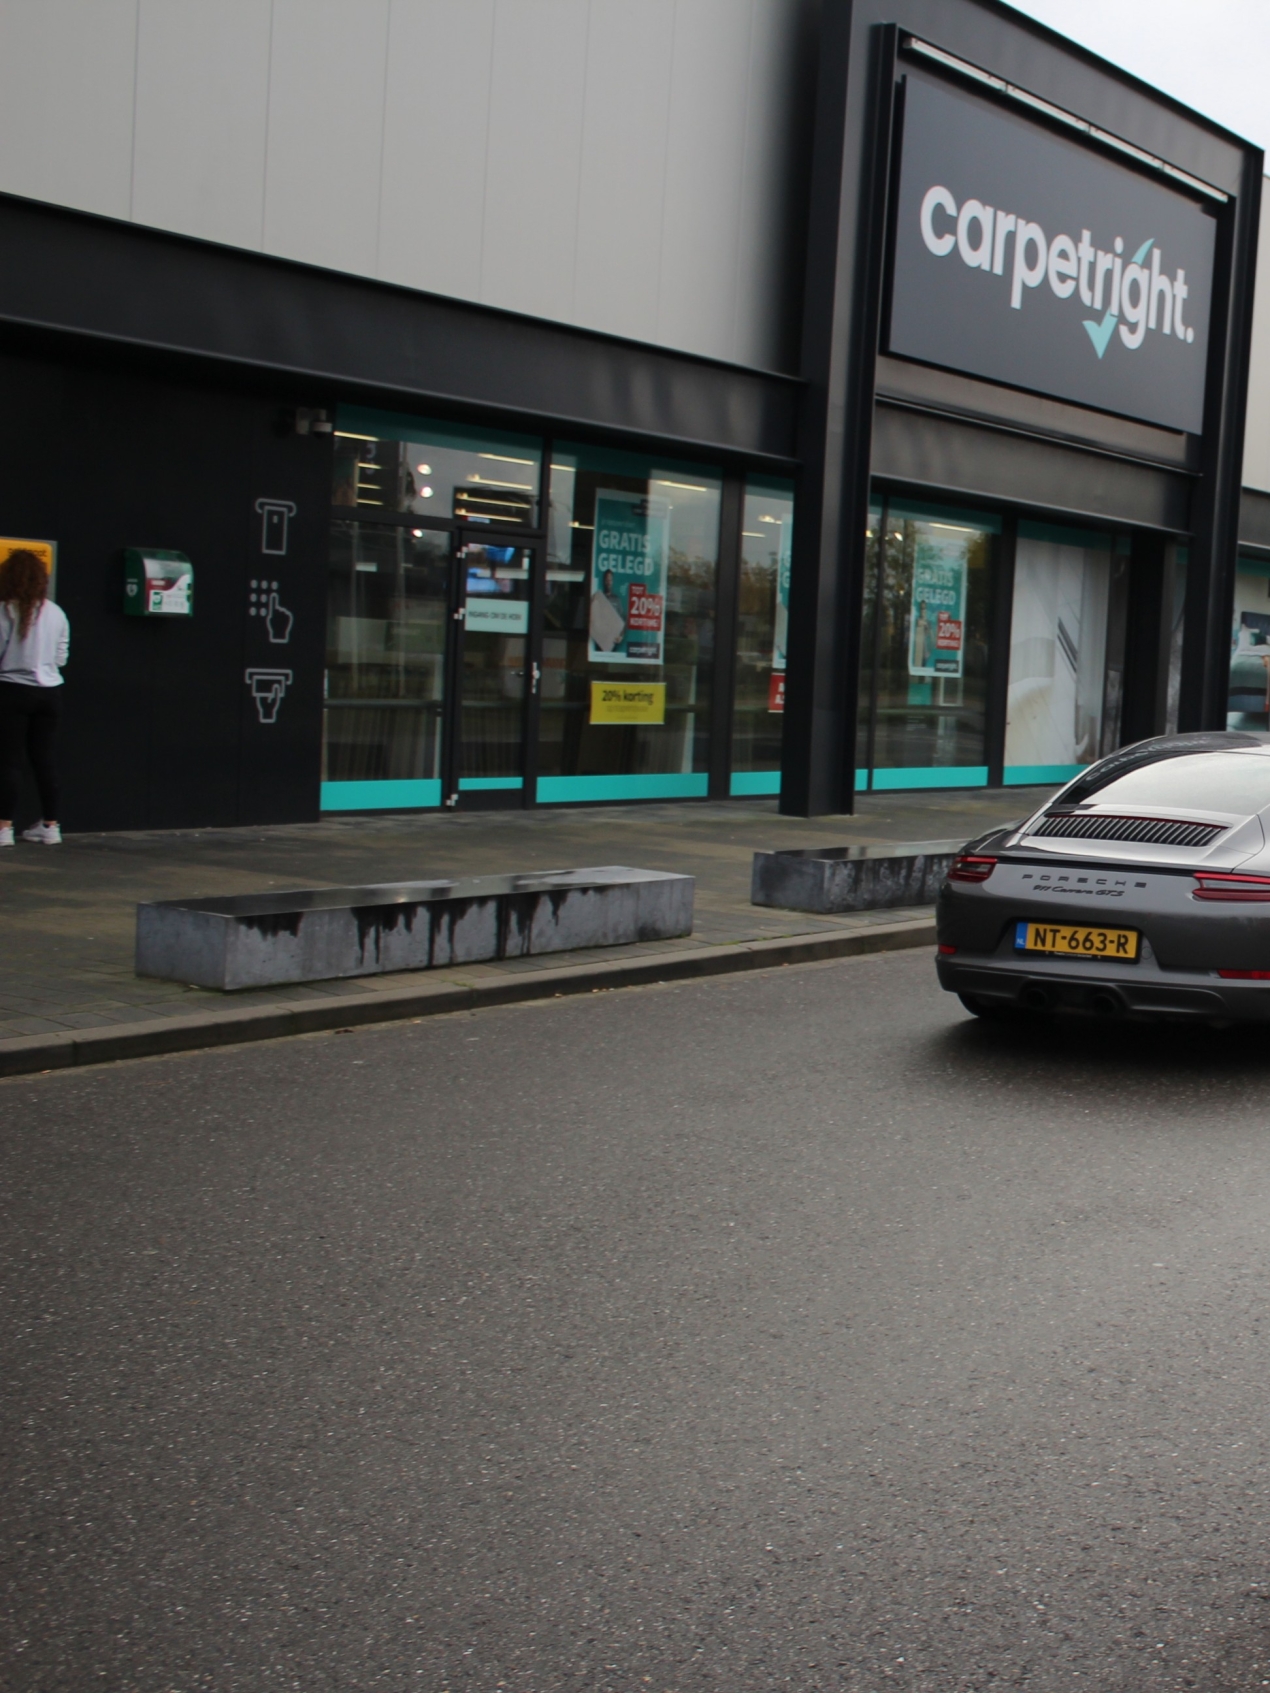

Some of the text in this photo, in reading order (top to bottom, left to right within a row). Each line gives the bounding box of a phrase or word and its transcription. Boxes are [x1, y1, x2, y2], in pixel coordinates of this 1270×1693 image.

[599, 529, 650, 553] GRATIS
[598, 552, 655, 576] GELEGD
[917, 568, 954, 587] GRATIS
[916, 587, 956, 605] GELEGD
[630, 596, 661, 617] 20%
[1022, 874, 1147, 888] PORSCHE
[1052, 886, 1093, 895] Carrera
[1096, 889, 1125, 897] GTS
[1033, 927, 1129, 954] NT-663-R
